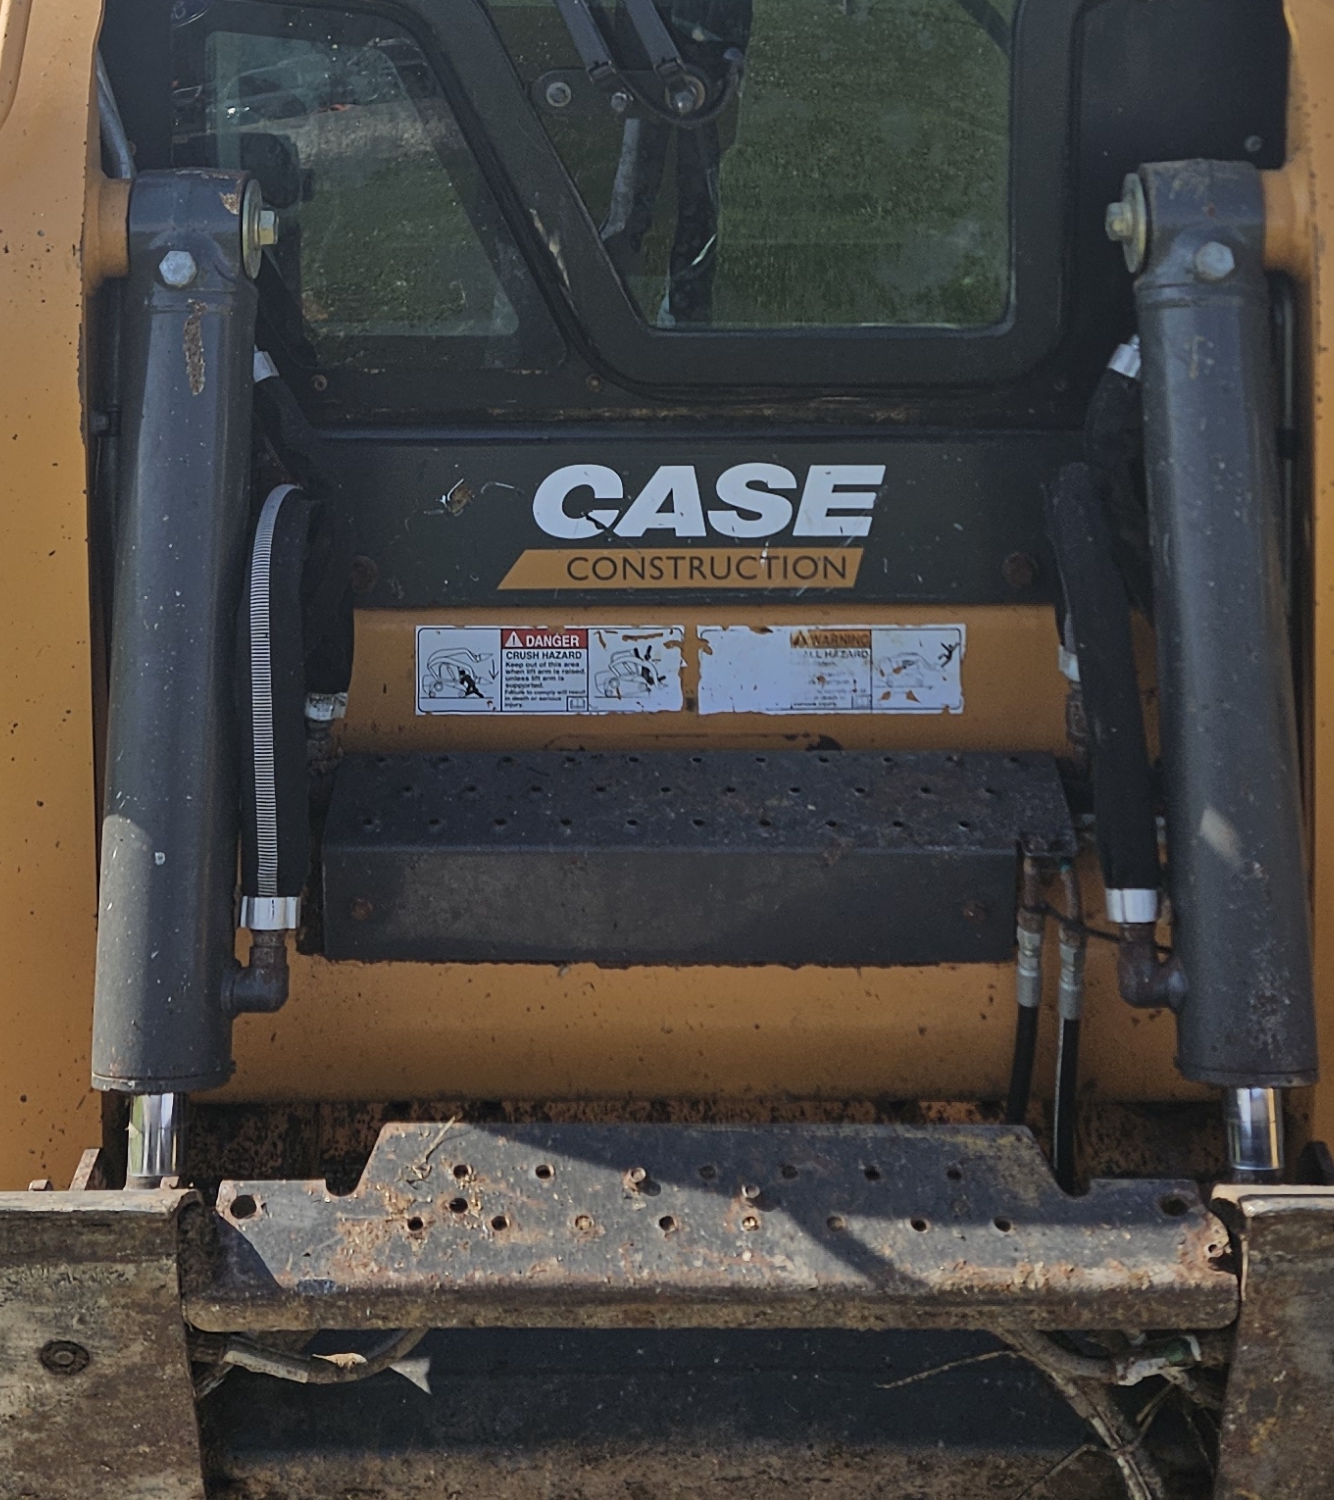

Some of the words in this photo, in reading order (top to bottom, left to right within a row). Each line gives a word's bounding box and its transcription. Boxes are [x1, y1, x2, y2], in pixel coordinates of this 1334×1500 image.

[532, 463, 886, 539] CASE
[566, 555, 847, 582] CONSTRUCTION
[526, 635, 580, 648] DANGER
[810, 633, 870, 647] WARNING
[506, 651, 539, 660] CRUSH
[542, 651, 582, 660] HAZARD
